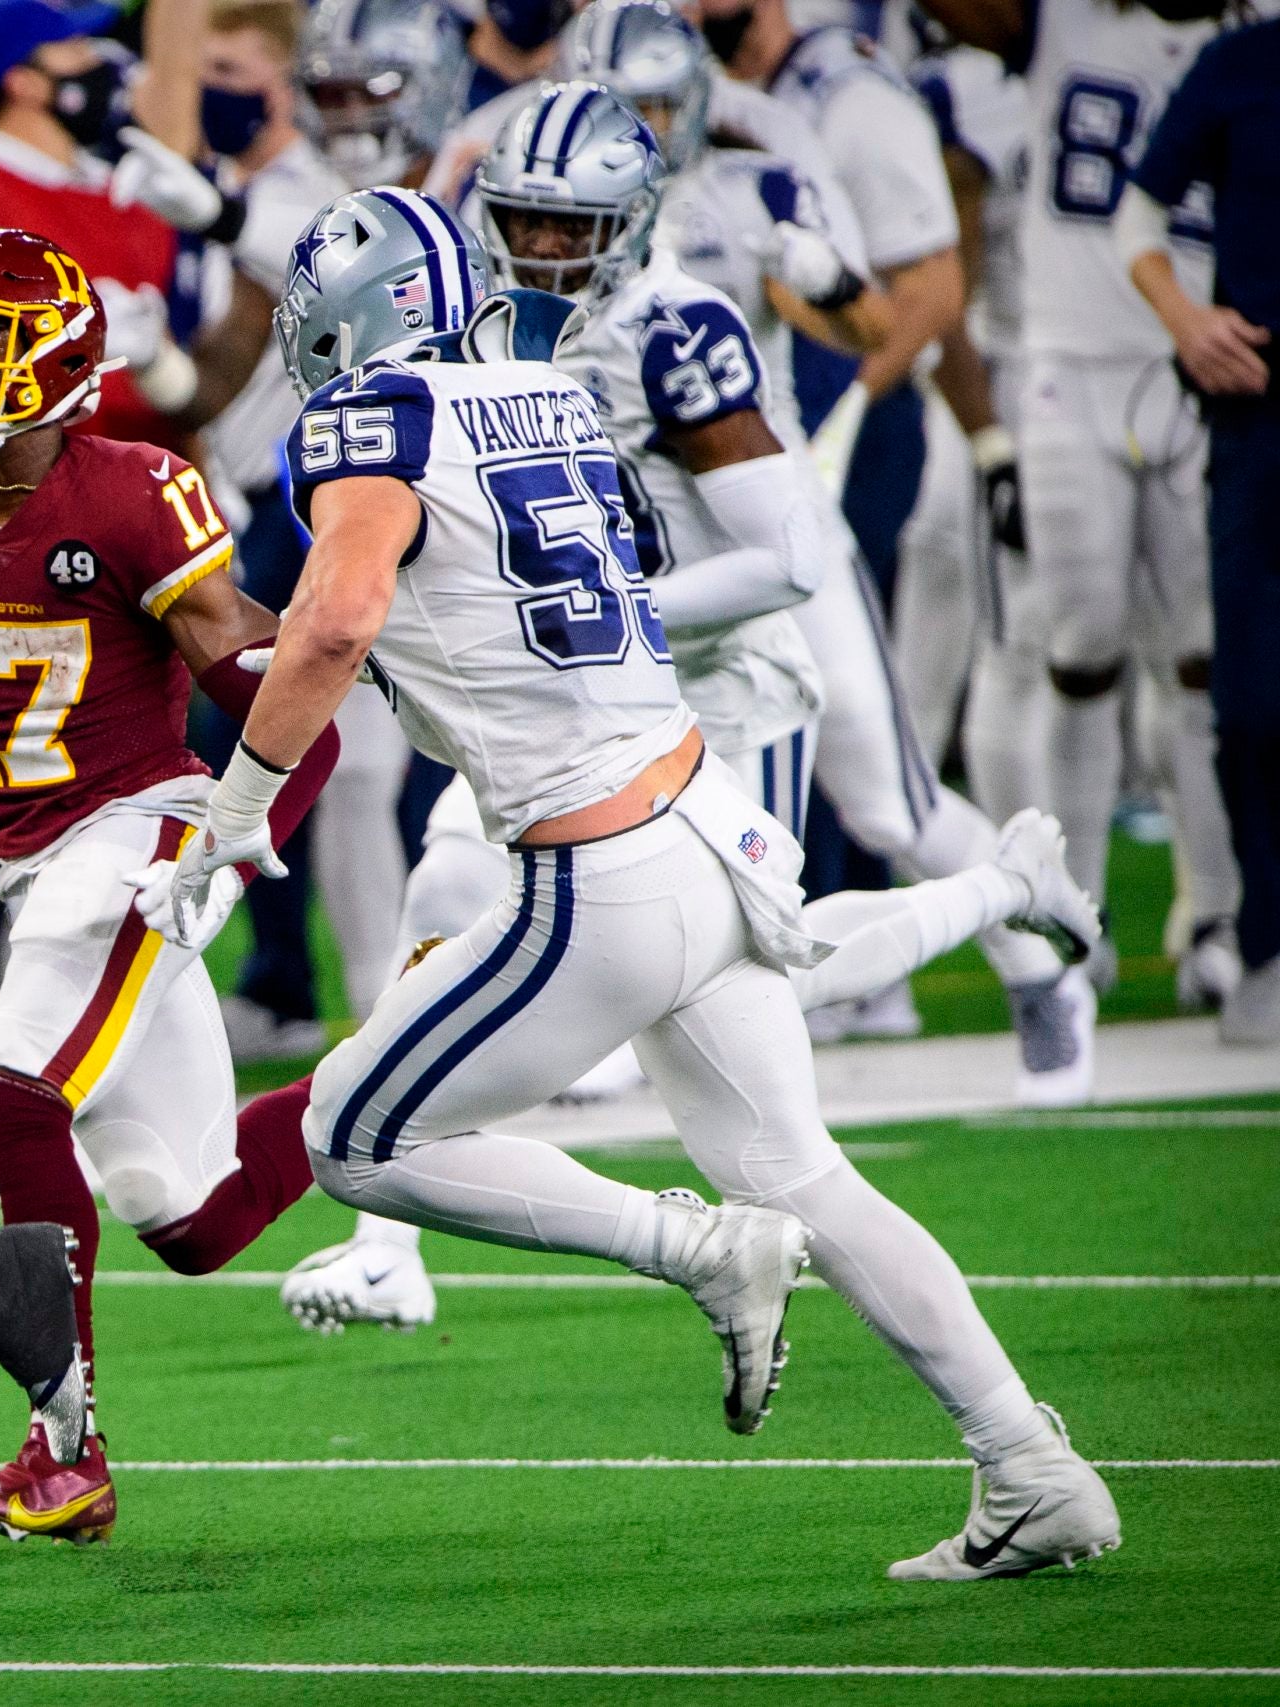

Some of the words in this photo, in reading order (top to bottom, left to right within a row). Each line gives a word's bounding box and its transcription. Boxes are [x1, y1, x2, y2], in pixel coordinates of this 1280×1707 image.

[43, 251, 91, 306] 17
[404, 314, 422, 326] MP
[661, 334, 754, 422] 33
[301, 406, 397, 473] 55
[162, 466, 225, 552] 17
[50, 550, 95, 584] 49
